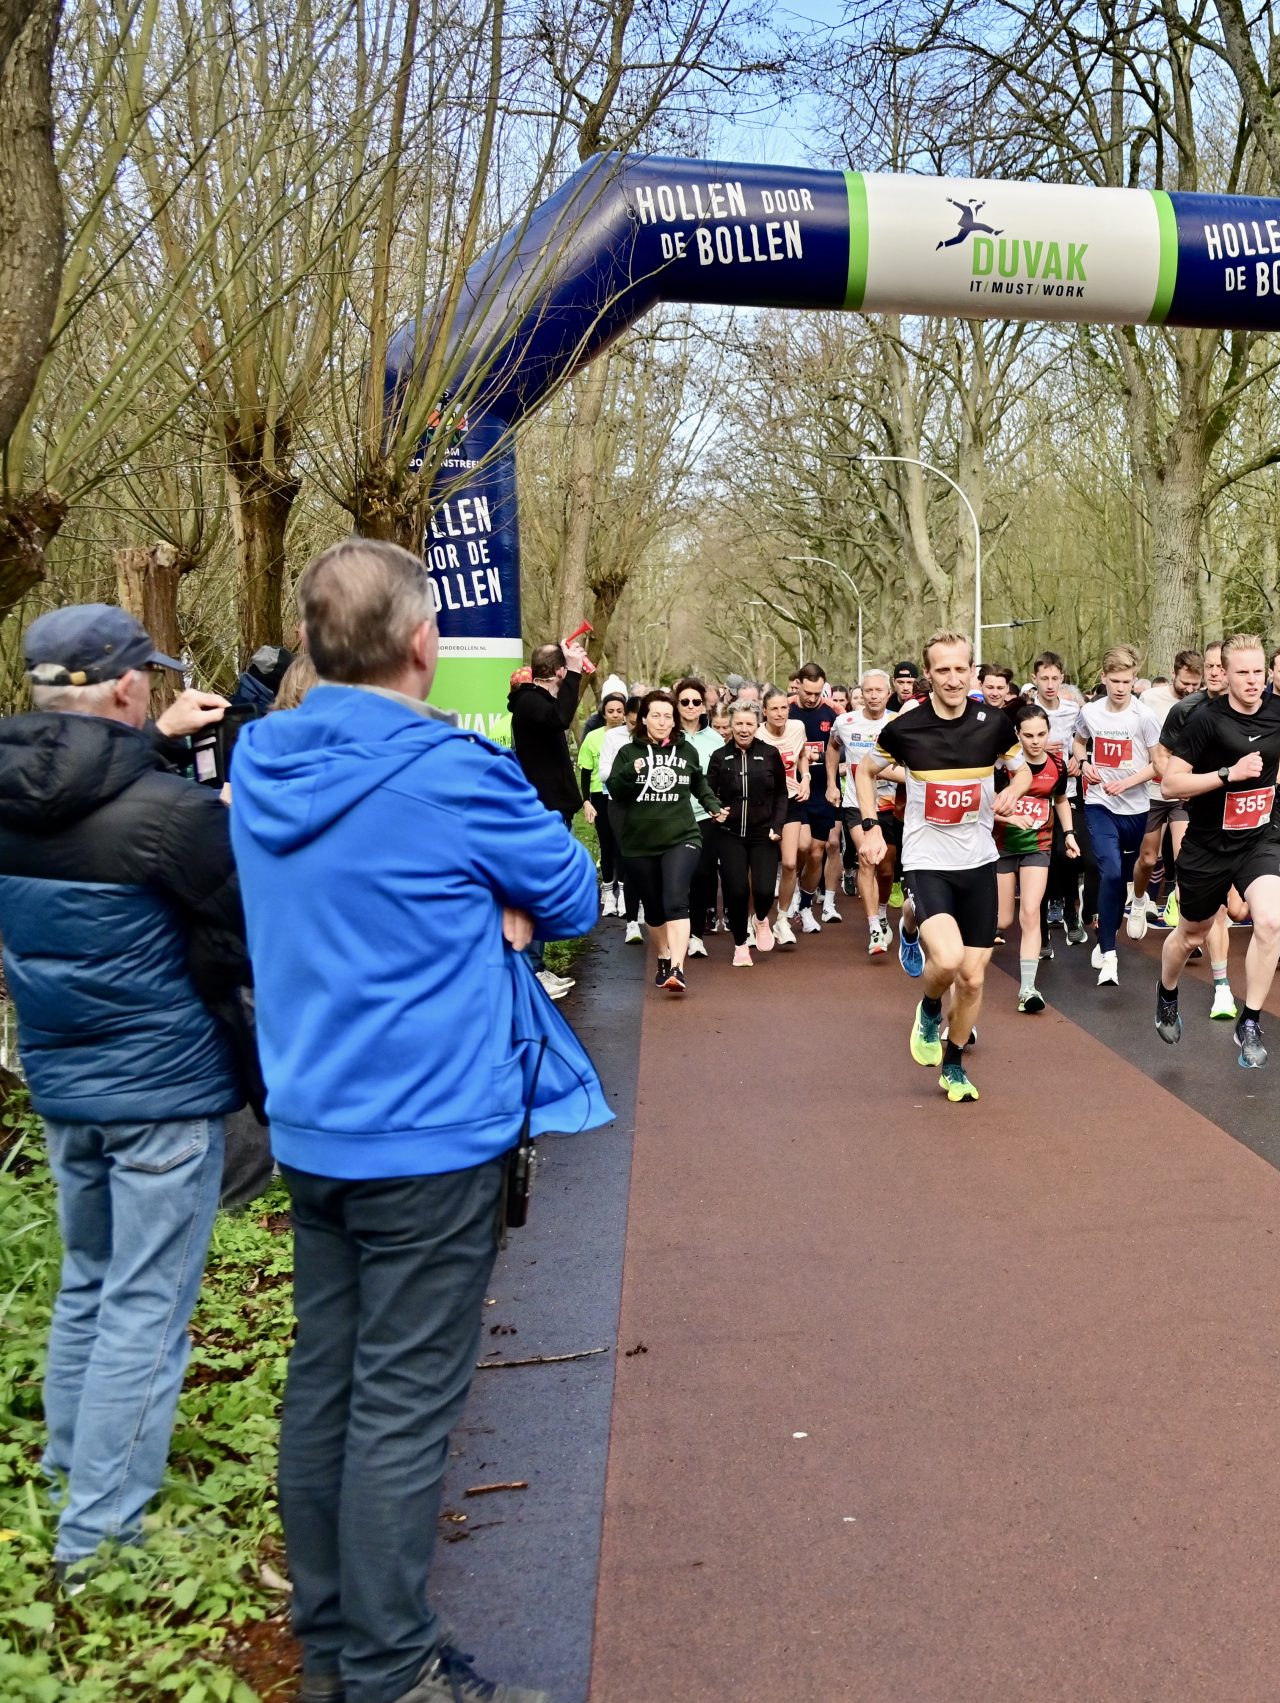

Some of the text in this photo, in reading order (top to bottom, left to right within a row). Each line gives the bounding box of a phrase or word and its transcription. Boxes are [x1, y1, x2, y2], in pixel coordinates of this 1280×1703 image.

[636, 182, 815, 224] HOLLEN DOOR
[661, 219, 804, 266] DE BOLLEN
[972, 237, 1089, 281] DUVAK
[1225, 266, 1247, 291] DE
[427, 495, 492, 539] LLEN
[467, 539, 490, 566] DE
[426, 567, 503, 613] OLLEN
[457, 712, 503, 736] VAK
[1103, 742, 1122, 757] 171
[643, 793, 680, 802] RELAND
[935, 789, 973, 809] 305
[1015, 800, 1043, 817] 334
[1235, 794, 1267, 815] 355
